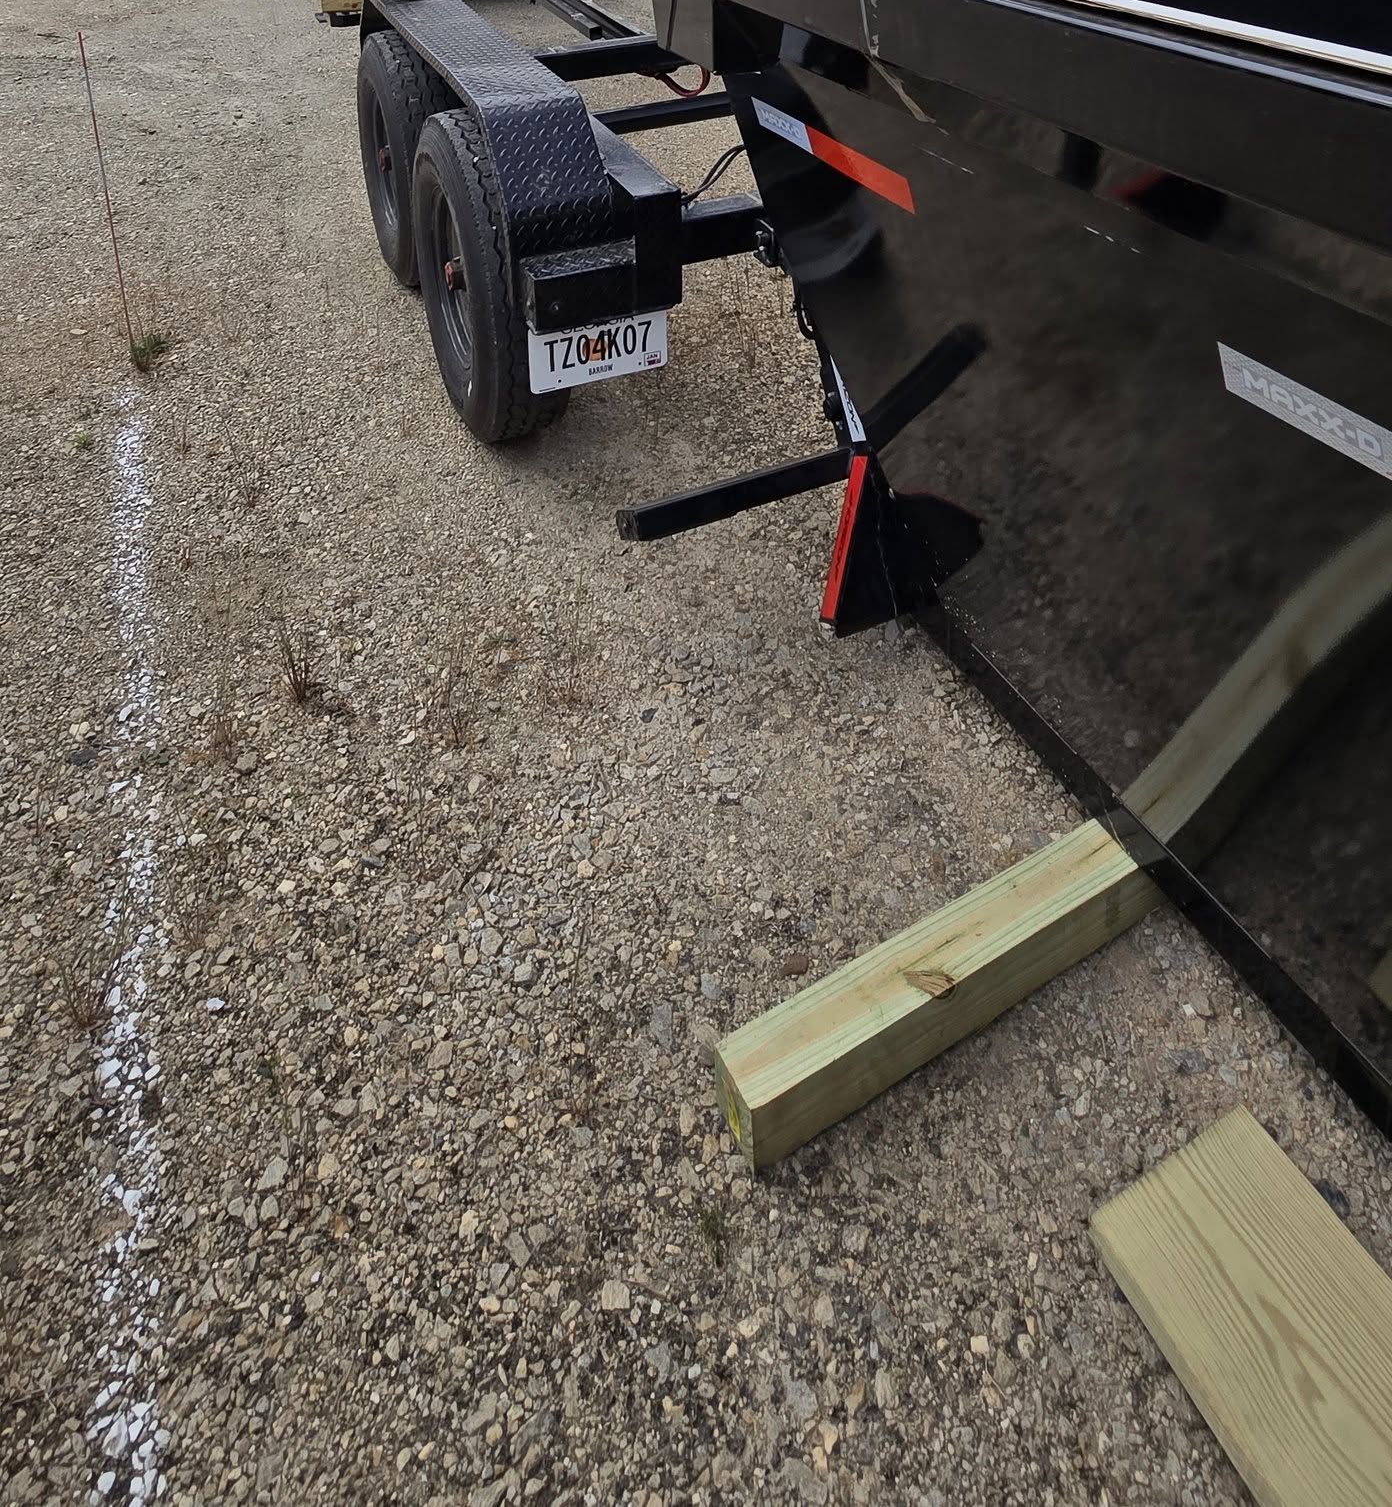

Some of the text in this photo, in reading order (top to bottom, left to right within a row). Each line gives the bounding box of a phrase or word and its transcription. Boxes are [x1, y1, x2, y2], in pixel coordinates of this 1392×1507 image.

[544, 320, 652, 372] TZ04K07
[588, 363, 613, 375] BARROW
[1242, 368, 1382, 458] MAXX-D
